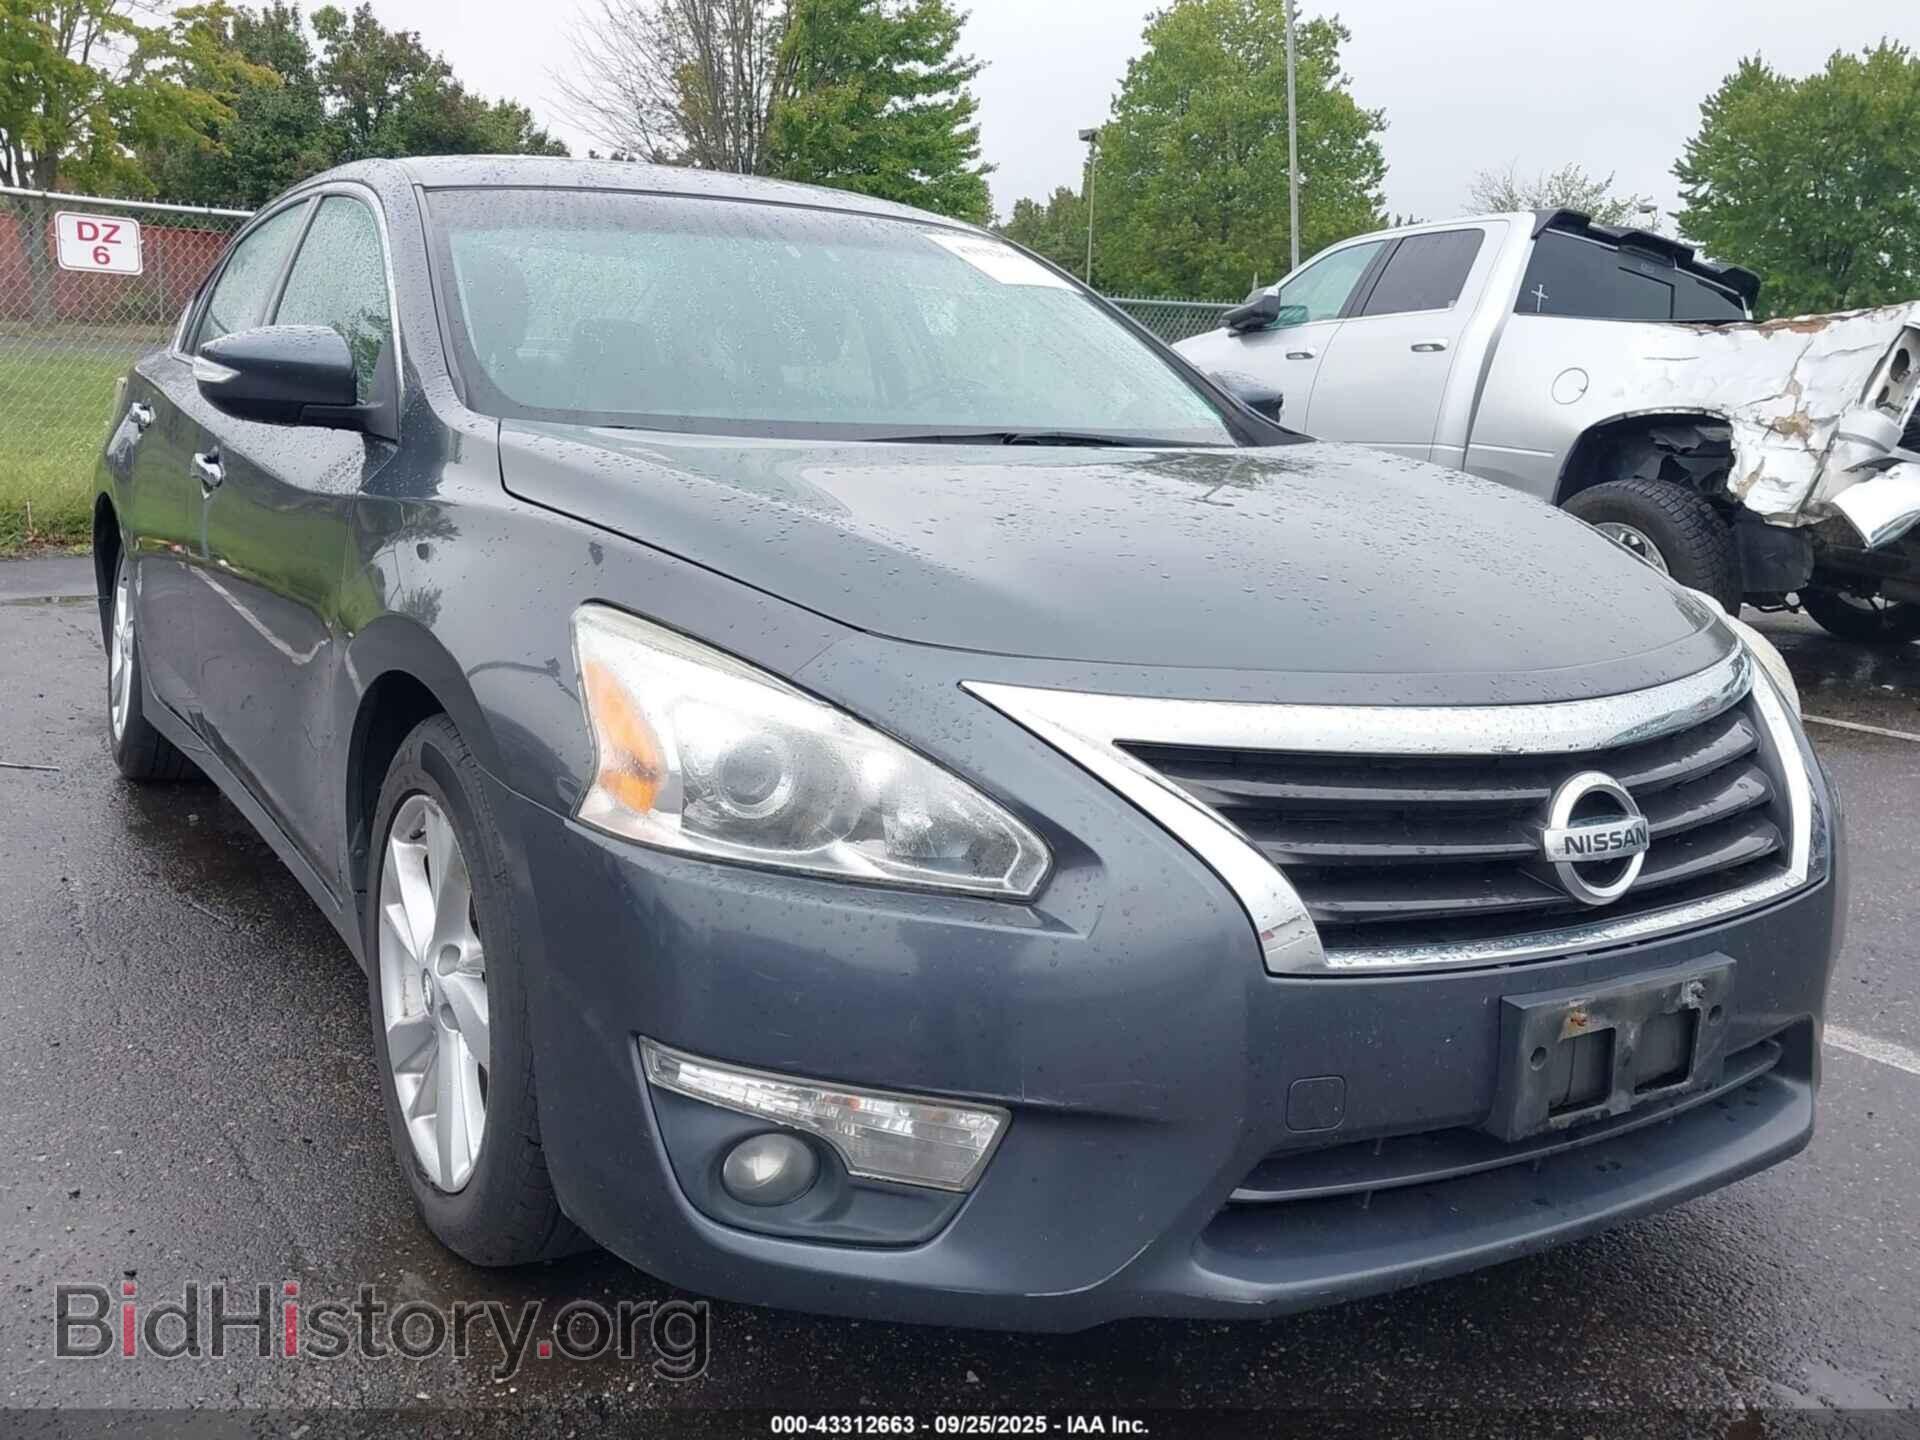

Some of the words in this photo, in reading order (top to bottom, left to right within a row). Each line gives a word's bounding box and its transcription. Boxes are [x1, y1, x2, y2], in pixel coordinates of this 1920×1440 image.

[77, 221, 121, 244] DZ
[93, 246, 110, 265] 6
[1564, 827, 1647, 855] NISSAN
